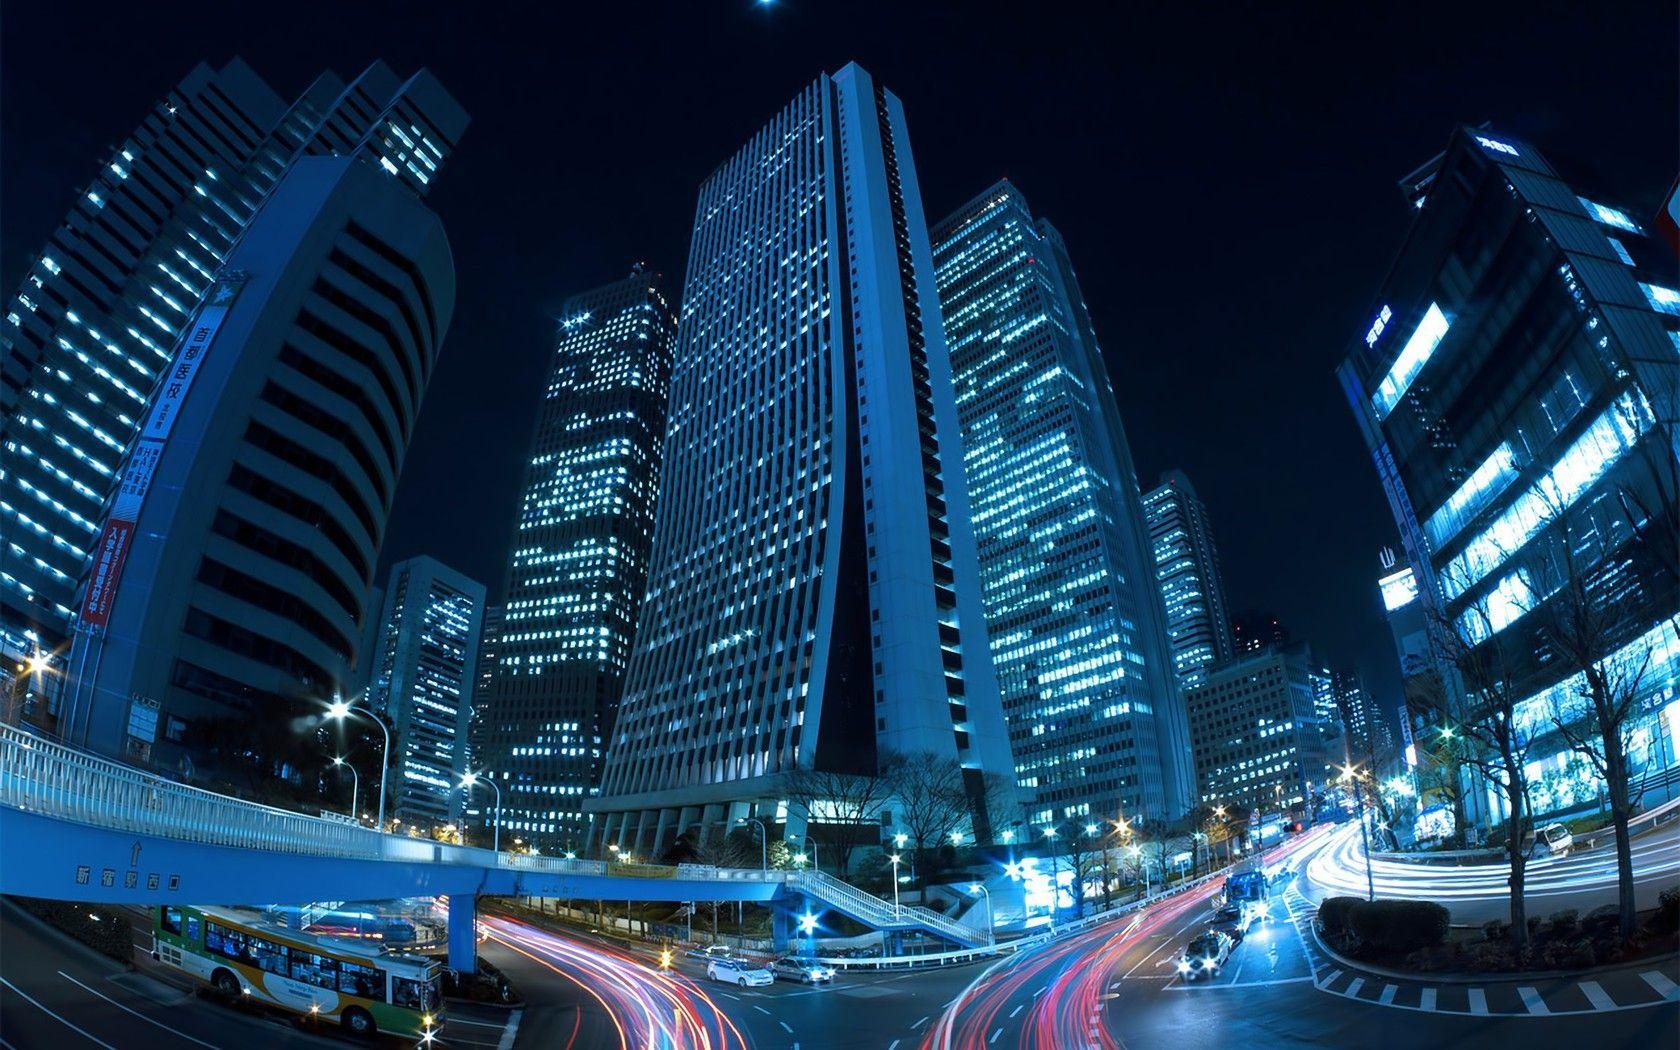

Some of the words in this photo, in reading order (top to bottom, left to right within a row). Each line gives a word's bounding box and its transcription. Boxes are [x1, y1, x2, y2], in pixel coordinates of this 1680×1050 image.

[76, 865, 181, 891] 新宿駅西口
